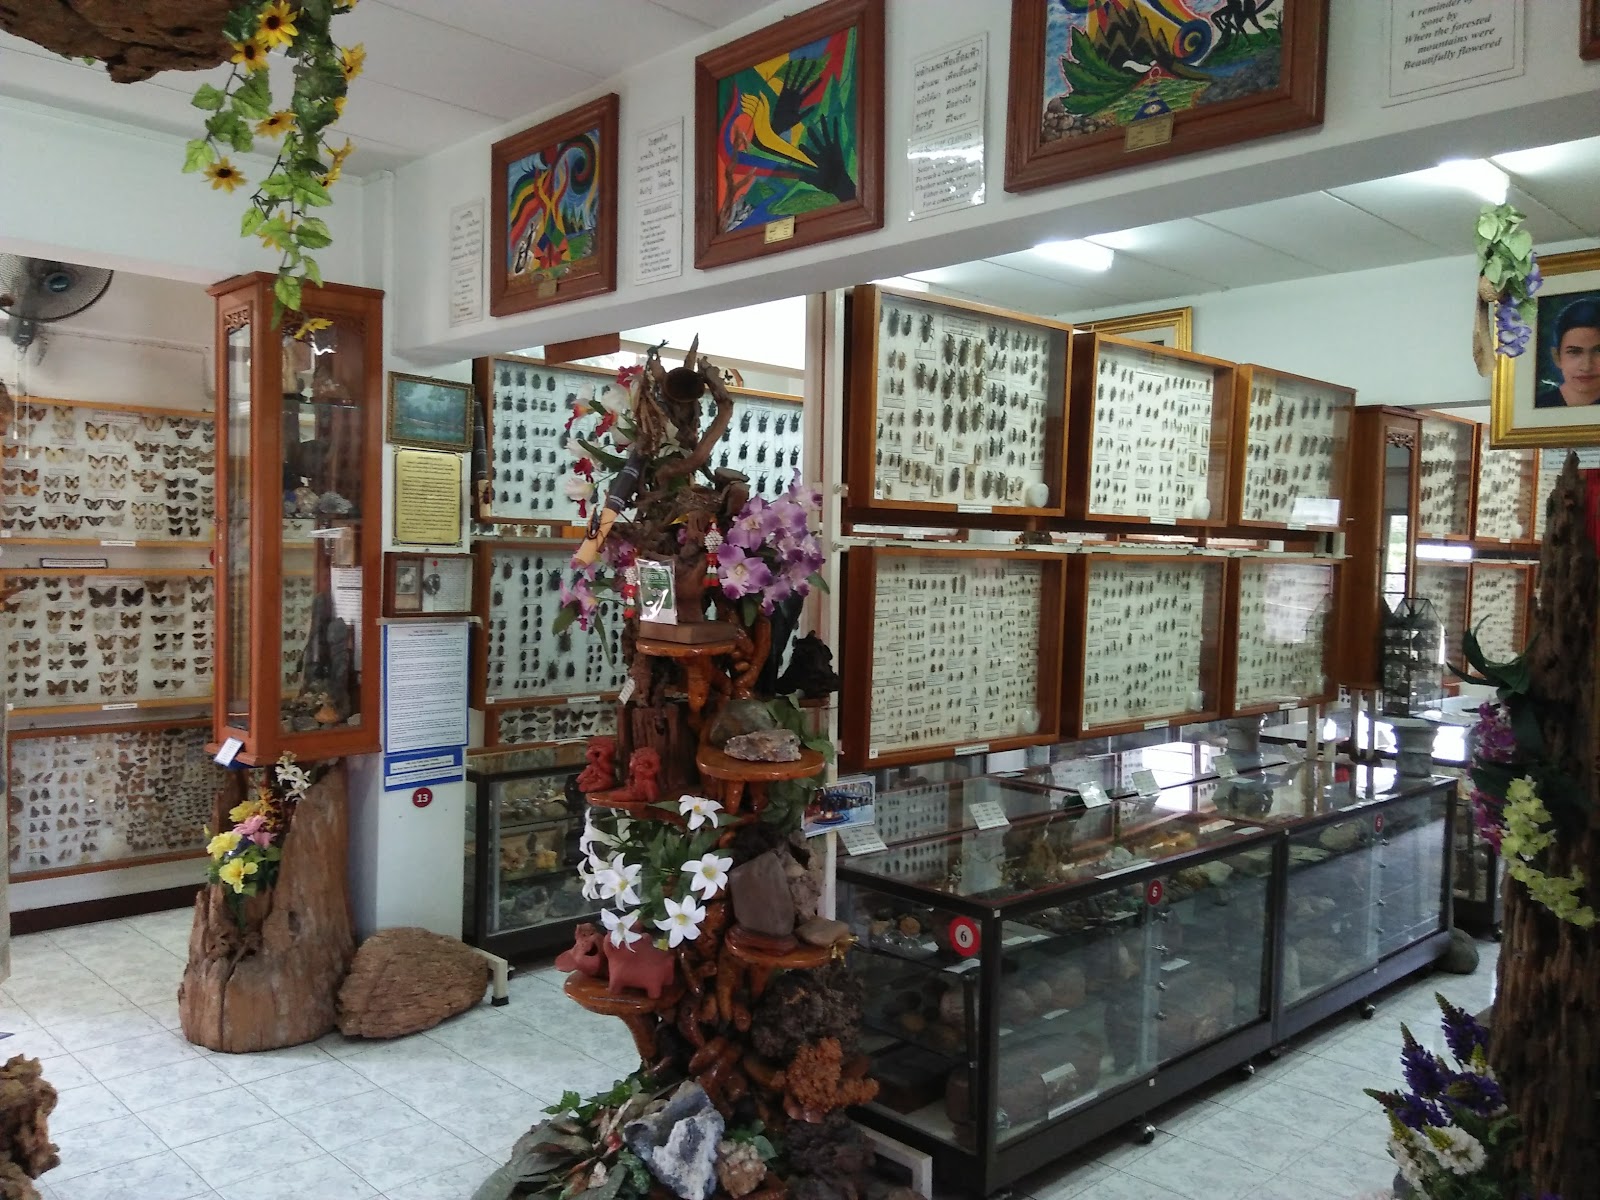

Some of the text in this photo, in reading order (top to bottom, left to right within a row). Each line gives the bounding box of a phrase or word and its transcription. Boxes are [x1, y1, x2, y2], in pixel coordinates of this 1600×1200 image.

[1404, 14, 1492, 44] When the forested
[1420, 11, 1458, 29] gone by
[1417, 28, 1495, 54] mountains were
[1403, 37, 1503, 70] Beautifully flowered
[417, 793, 429, 803] 13
[1152, 886, 1158, 898] 6
[960, 930, 967, 943] 6
